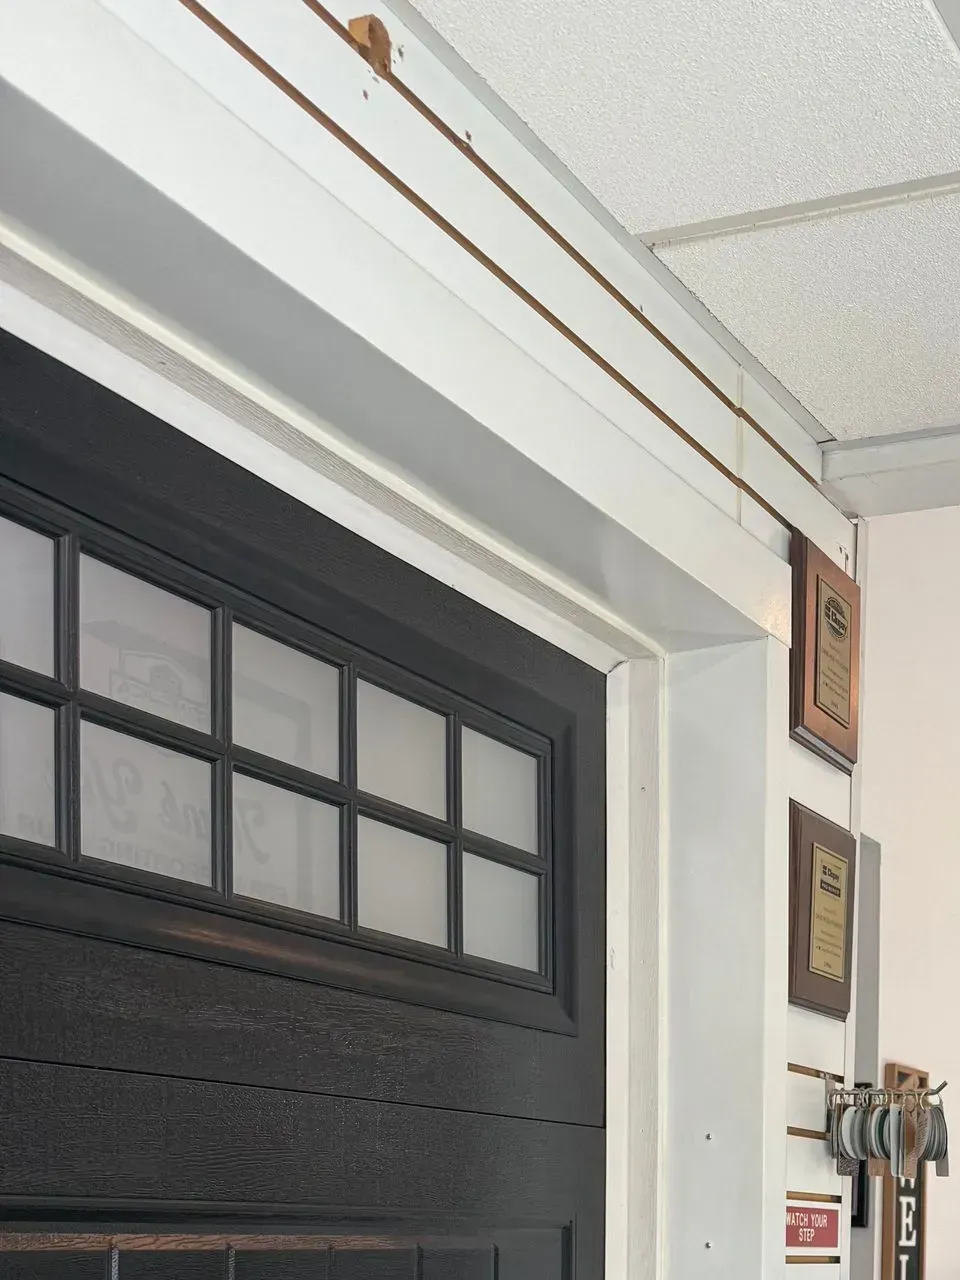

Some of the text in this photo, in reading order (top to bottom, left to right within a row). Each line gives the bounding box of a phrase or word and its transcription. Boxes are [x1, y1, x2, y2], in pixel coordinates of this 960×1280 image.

[786, 1212, 828, 1227] WATCH YOUR
[799, 1228, 815, 1242] STEP
